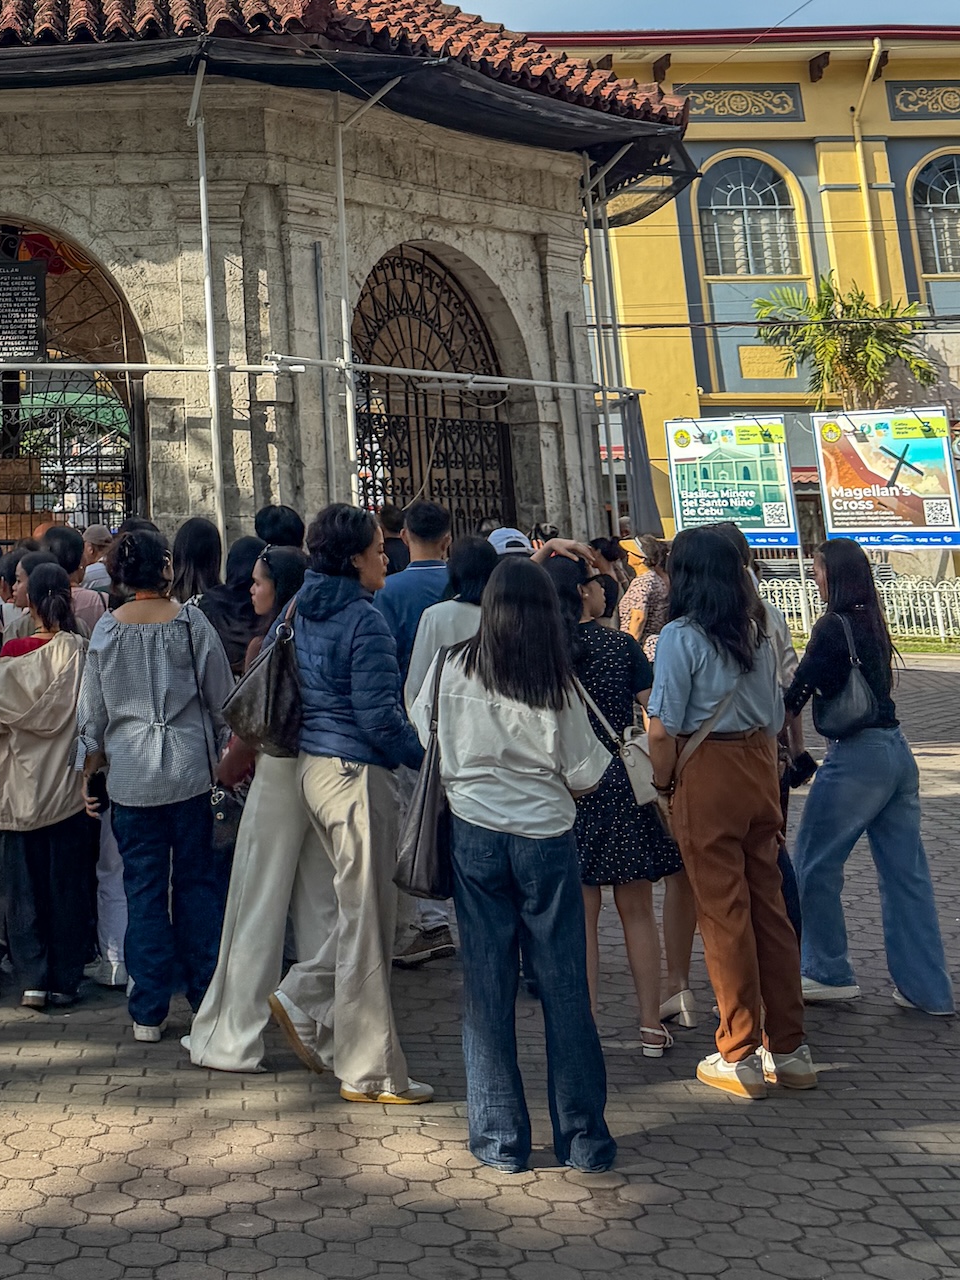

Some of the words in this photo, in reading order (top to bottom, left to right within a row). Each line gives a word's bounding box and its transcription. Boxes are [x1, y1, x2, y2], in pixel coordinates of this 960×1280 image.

[681, 490, 719, 499] Basilica
[720, 488, 756, 498] Minore
[831, 484, 912, 499] Magellan's
[682, 499, 698, 507] del
[700, 499, 728, 507] Santo
[730, 498, 754, 507] Niño
[832, 499, 874, 510] Cross
[683, 507, 696, 516] de
[697, 507, 724, 516] Cebu
